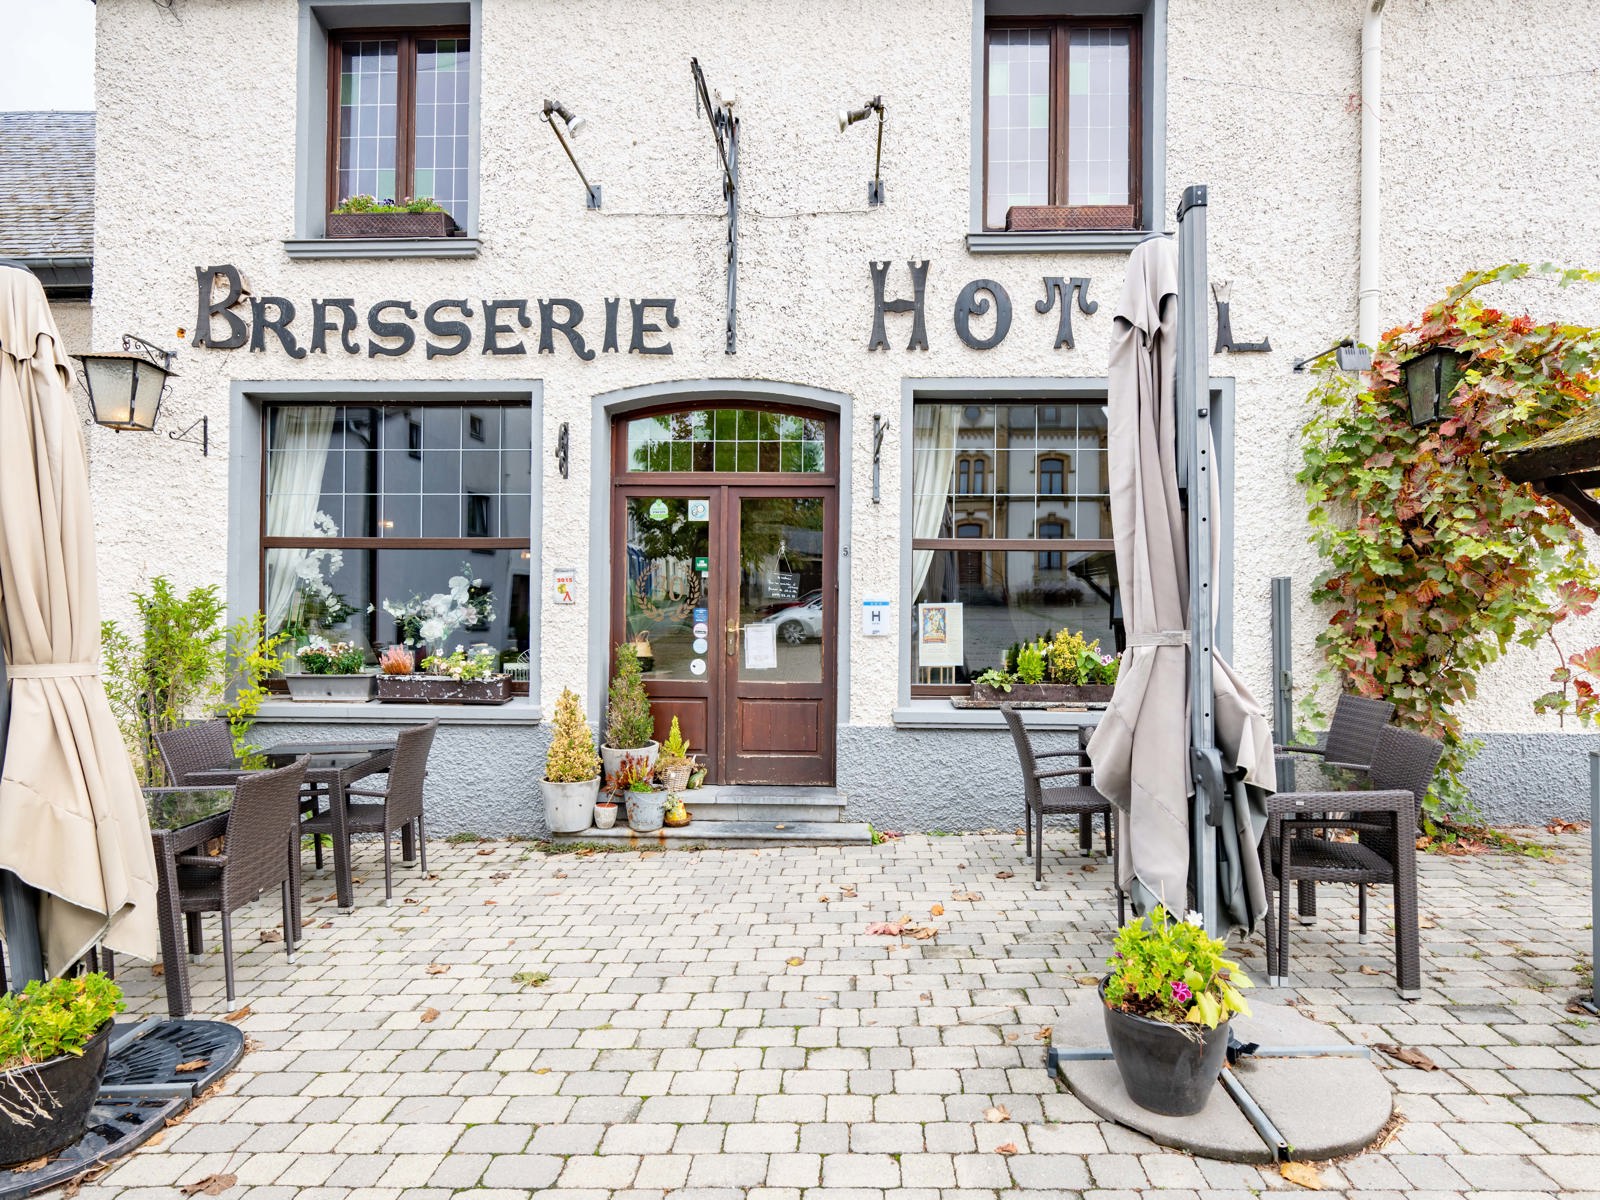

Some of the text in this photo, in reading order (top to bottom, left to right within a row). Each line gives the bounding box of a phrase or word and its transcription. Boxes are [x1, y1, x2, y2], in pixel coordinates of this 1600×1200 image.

[192, 264, 680, 361] BRASSERIE
[868, 260, 1272, 354] HOTL
[843, 547, 849, 556] 5
[871, 611, 880, 622] H
